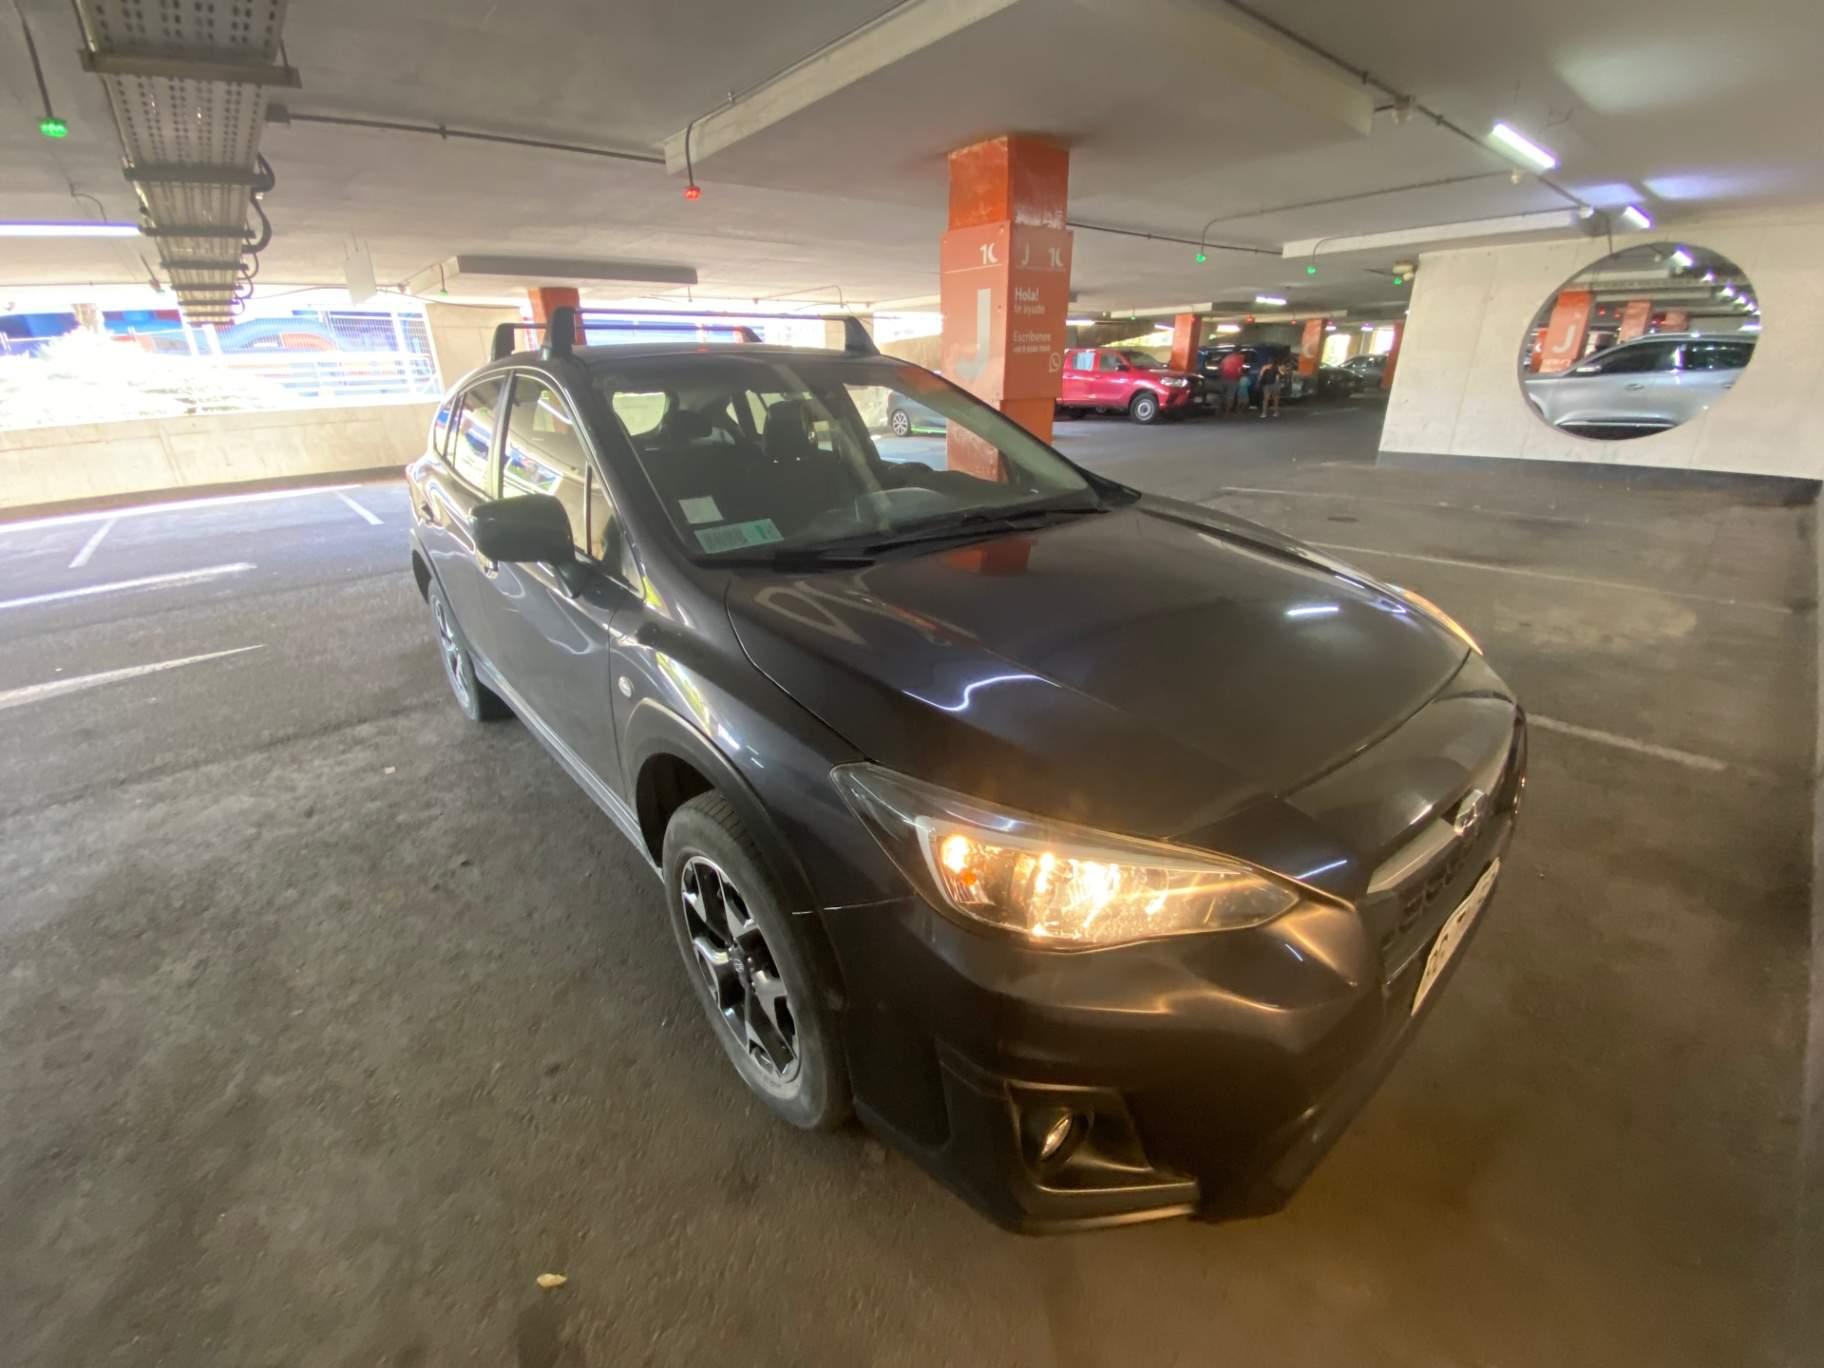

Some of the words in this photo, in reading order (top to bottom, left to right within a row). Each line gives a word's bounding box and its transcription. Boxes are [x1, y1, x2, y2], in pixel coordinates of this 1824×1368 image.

[1014, 287, 1040, 302] Hola!
[956, 288, 992, 380] J
[1552, 325, 1577, 353] J
